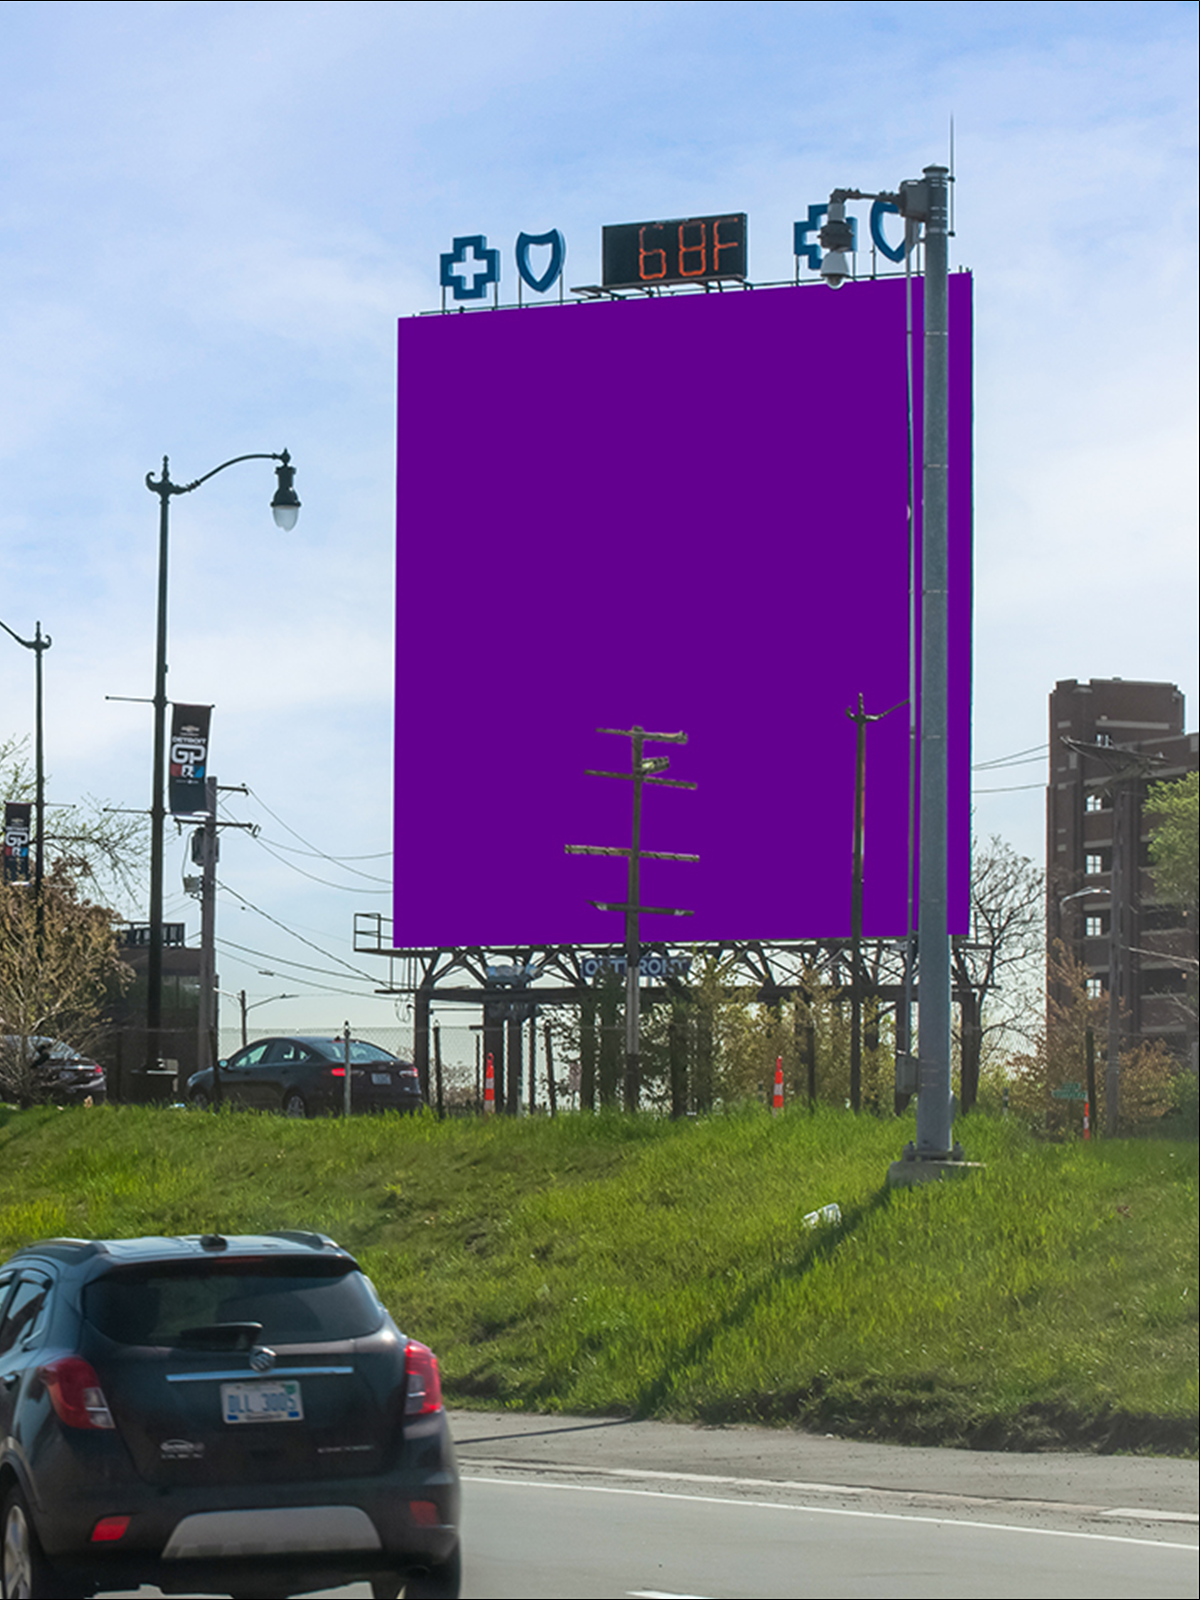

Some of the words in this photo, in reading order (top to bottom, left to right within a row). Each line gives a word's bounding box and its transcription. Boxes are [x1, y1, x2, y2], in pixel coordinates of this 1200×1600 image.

[638, 216, 739, 280] 68F
[172, 744, 206, 764] GP
[6, 831, 29, 847] GP
